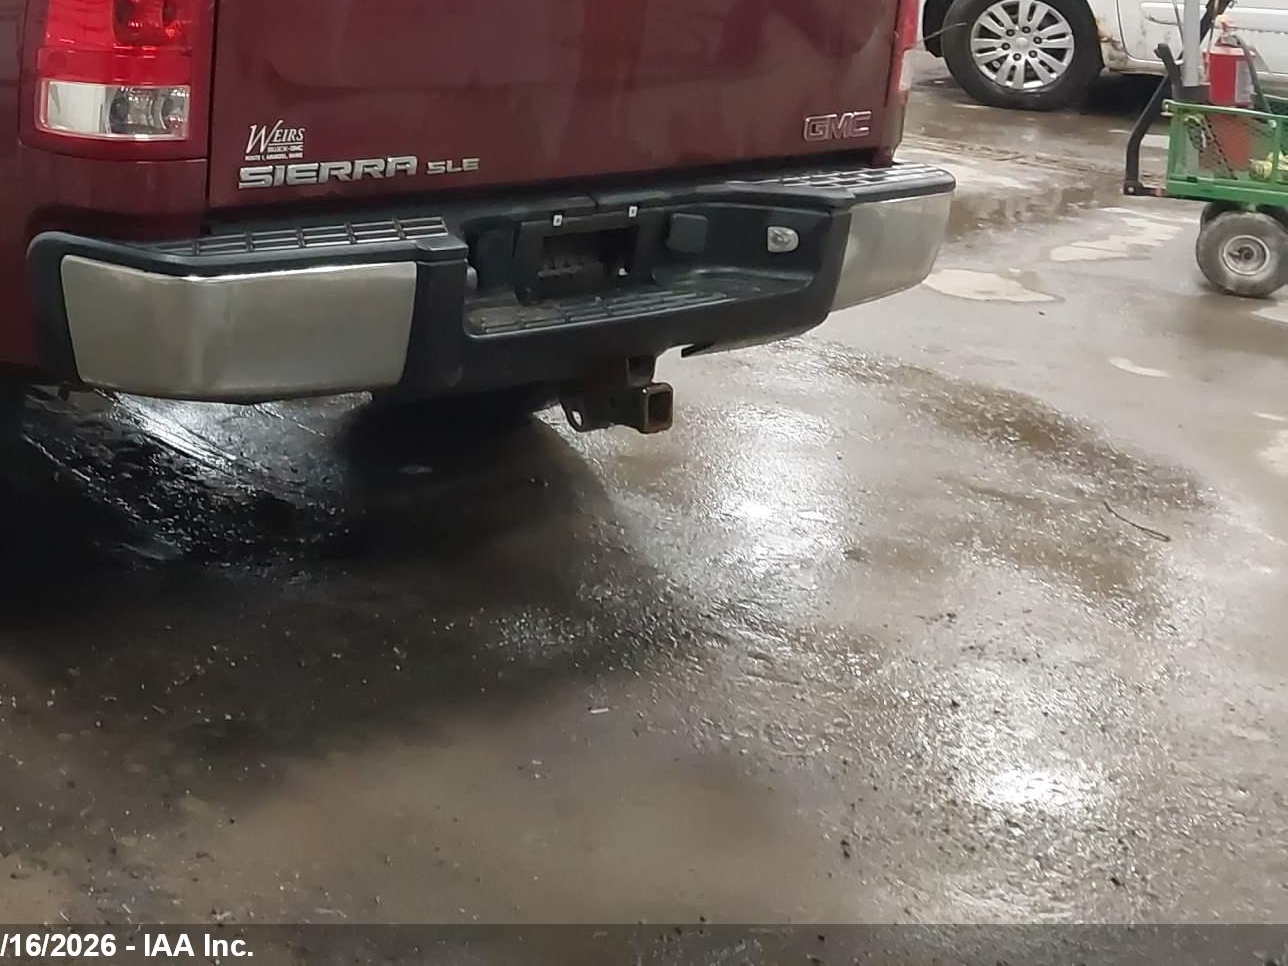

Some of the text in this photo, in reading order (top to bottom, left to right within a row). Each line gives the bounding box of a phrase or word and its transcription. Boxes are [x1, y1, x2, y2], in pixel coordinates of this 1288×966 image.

[803, 110, 872, 142] GMC
[238, 155, 480, 190] SIERRA SLE
